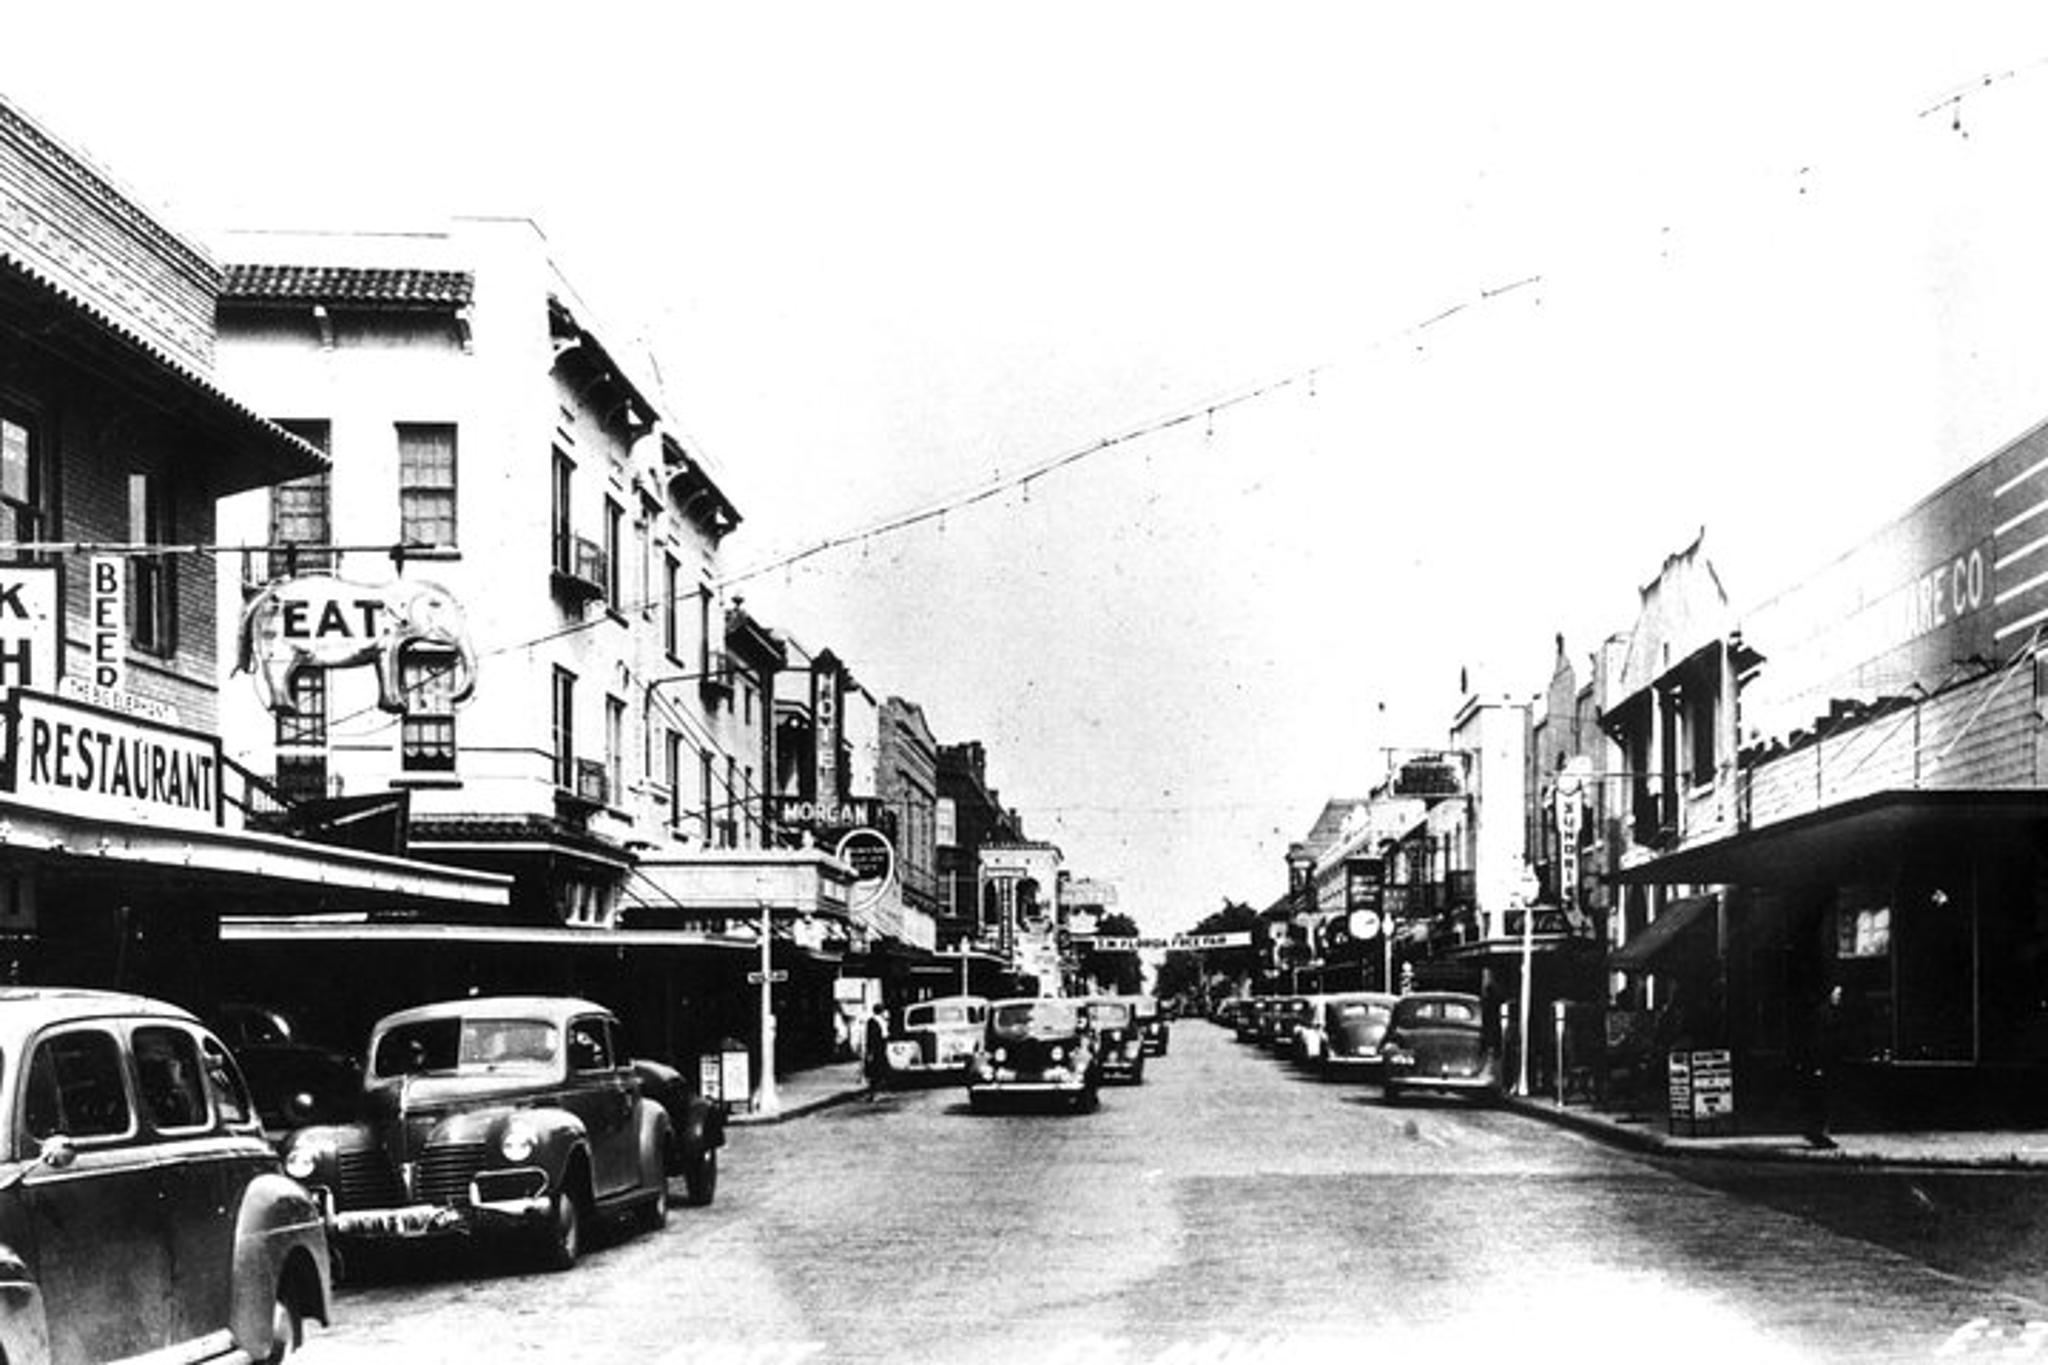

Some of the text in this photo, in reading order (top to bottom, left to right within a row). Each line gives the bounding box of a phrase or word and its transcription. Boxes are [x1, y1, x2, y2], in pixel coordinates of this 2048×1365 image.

[1953, 548, 1983, 615] CO
[283, 600, 385, 638] EAT
[30, 717, 212, 812] RESTAURANT
[783, 800, 869, 829] MORGAN
